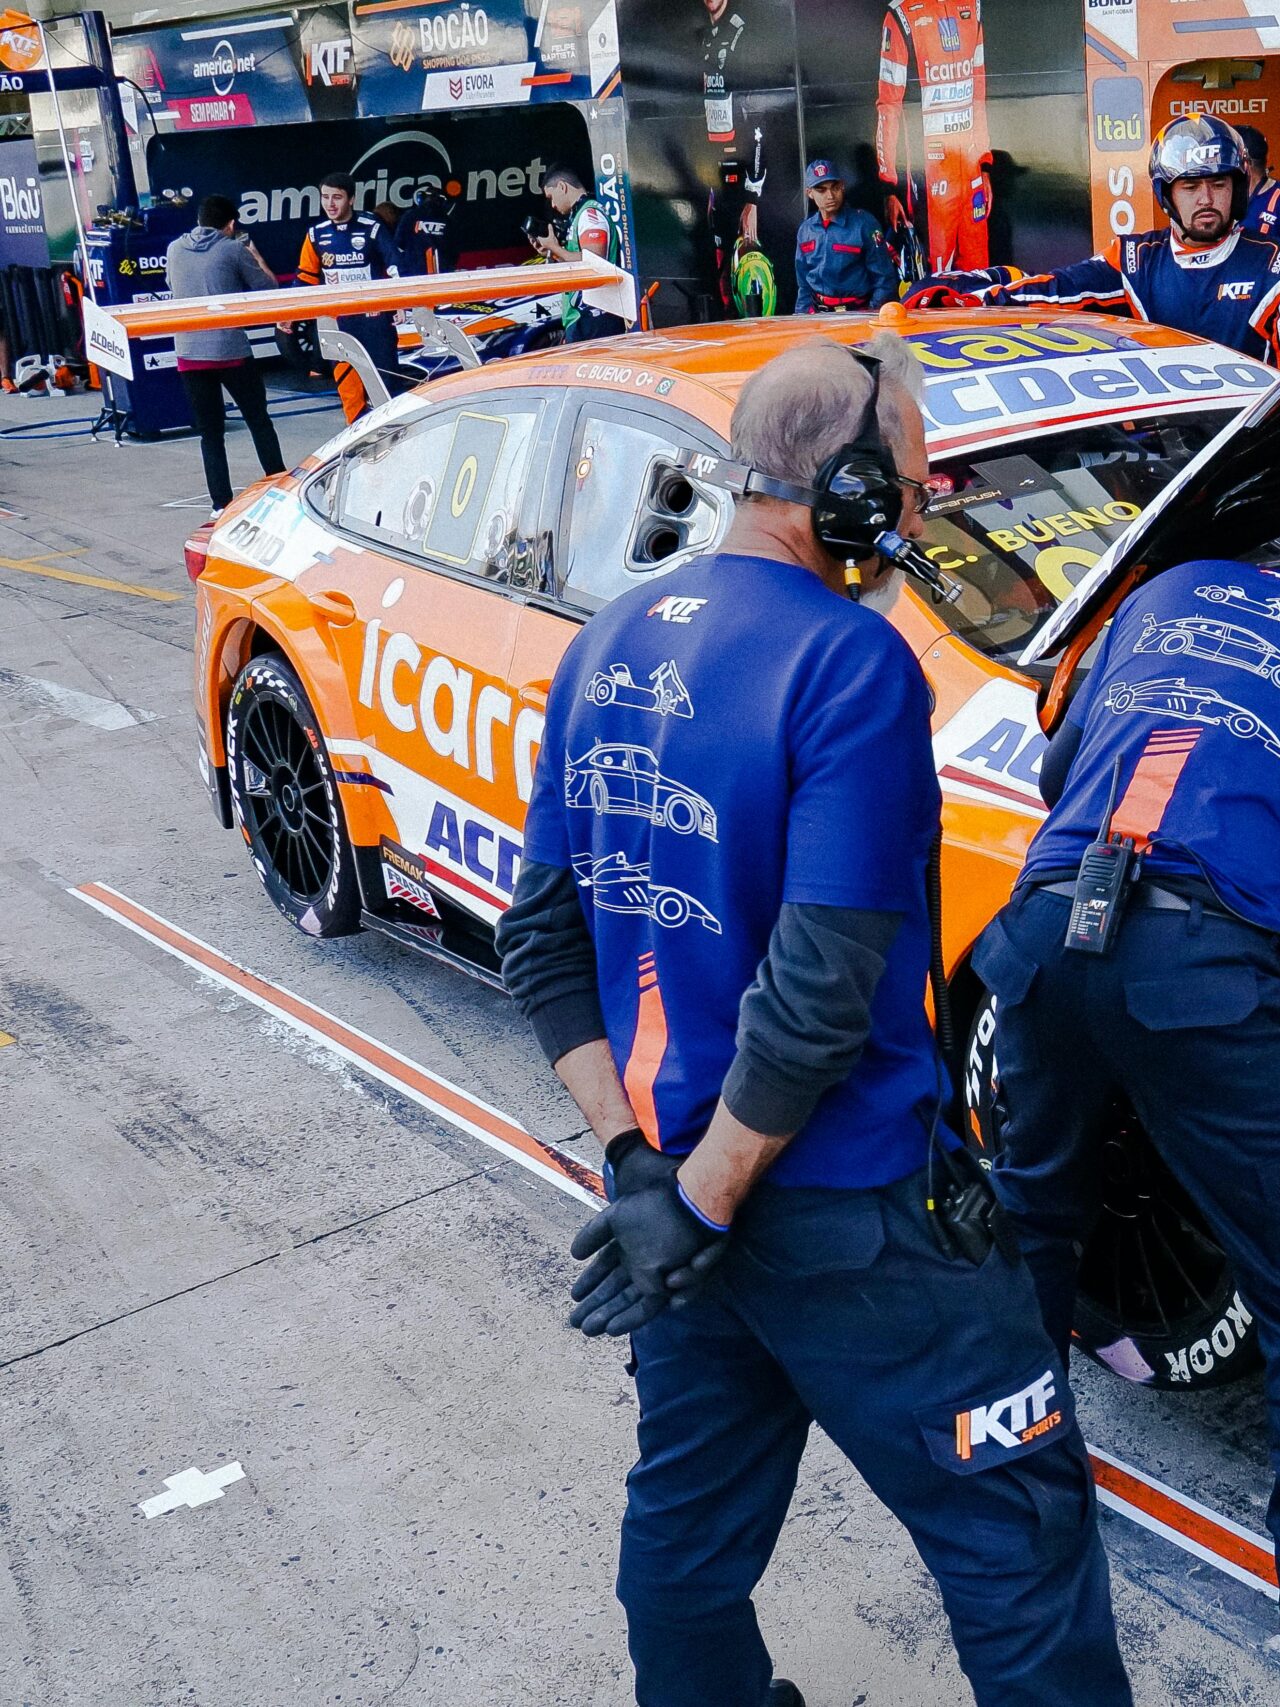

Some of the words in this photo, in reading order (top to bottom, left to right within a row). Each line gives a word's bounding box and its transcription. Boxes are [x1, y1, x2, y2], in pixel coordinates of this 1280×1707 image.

[419, 3, 489, 53] BOCÃO
[541, 49, 576, 62] BAPTISTA
[551, 43, 576, 53] FELIPE
[311, 39, 351, 86] KTF
[423, 55, 455, 70] SHOPPING
[465, 74, 494, 91] EVORA
[204, 101, 229, 122] PARAR
[1169, 98, 1269, 117] CHEVROLET
[943, 119, 971, 134] BOND
[1096, 113, 1141, 141] Itaú
[1186, 144, 1221, 165] KTF
[238, 157, 547, 225] amrica.net
[619, 187, 627, 210] DOS
[5, 223, 44, 235] FARMACÊUTICA
[418, 221, 447, 236] KTF
[621, 213, 632, 270] SHOPPING
[139, 256, 168, 270] BOC
[335, 252, 364, 266] BOCÃO
[1126, 240, 1137, 274] sparco
[1191, 253, 1211, 265] KTF
[1220, 281, 1255, 300] KTF
[90, 330, 126, 360] ACDelco
[910, 323, 1108, 369] taú
[575, 364, 587, 379] C.
[588, 364, 632, 384] BUENO
[926, 357, 1277, 432] CDelco
[691, 453, 719, 478] KTF
[450, 455, 477, 518] 0
[924, 545, 979, 570] C.
[985, 500, 1143, 553] BUENO
[657, 596, 709, 619] KTF
[359, 577, 547, 803] icarr
[382, 846, 424, 883] FREMAX
[965, 994, 997, 1107] STO
[970, 1369, 1055, 1449] KTF
[1021, 1410, 1062, 1445] SPORTS
